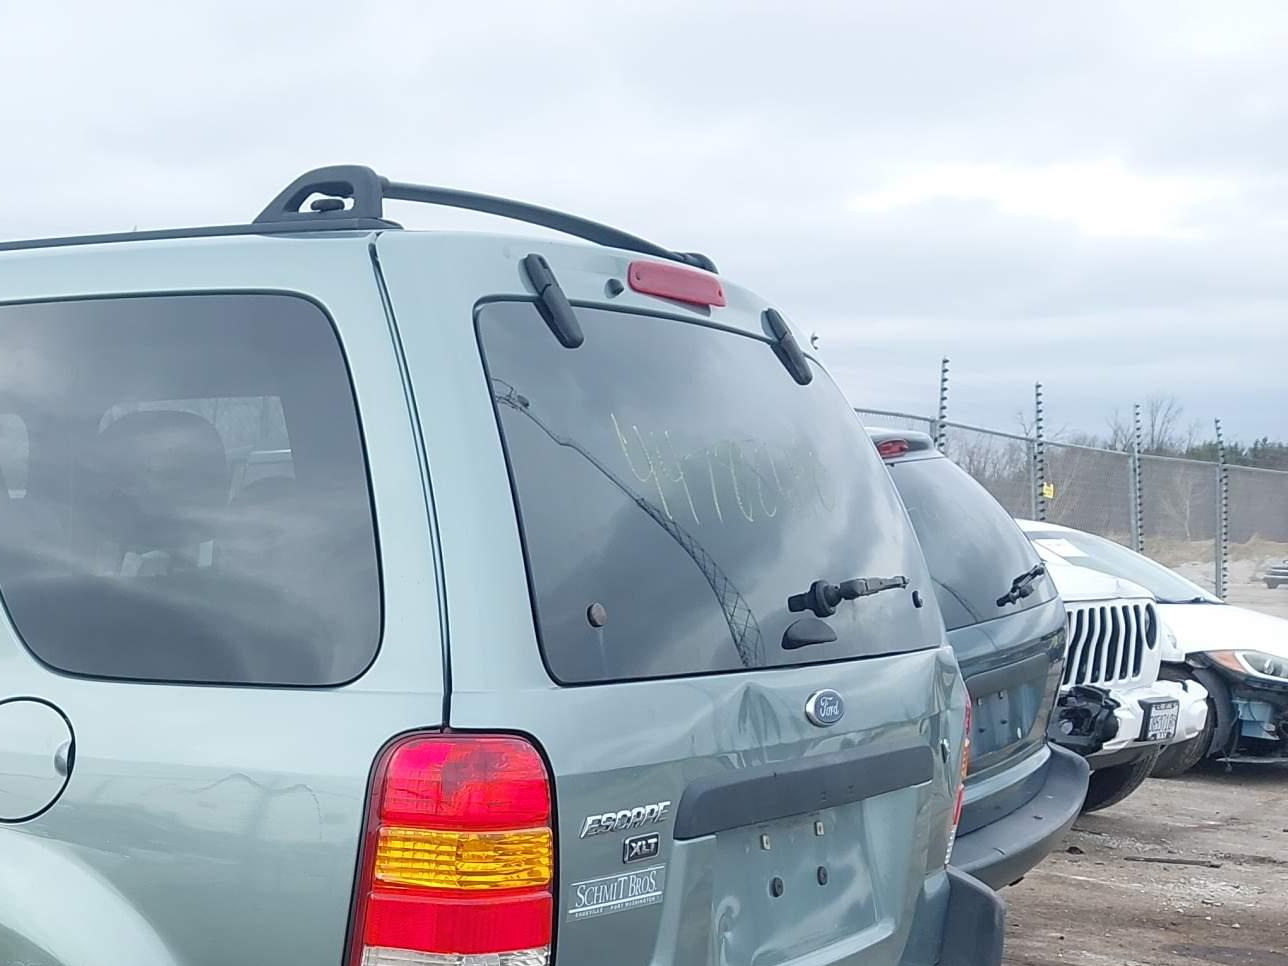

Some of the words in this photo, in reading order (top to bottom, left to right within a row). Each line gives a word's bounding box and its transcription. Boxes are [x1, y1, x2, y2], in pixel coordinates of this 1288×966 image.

[819, 695, 840, 718] Ford
[580, 801, 671, 839] ESCAPE
[629, 837, 658, 858] XLT
